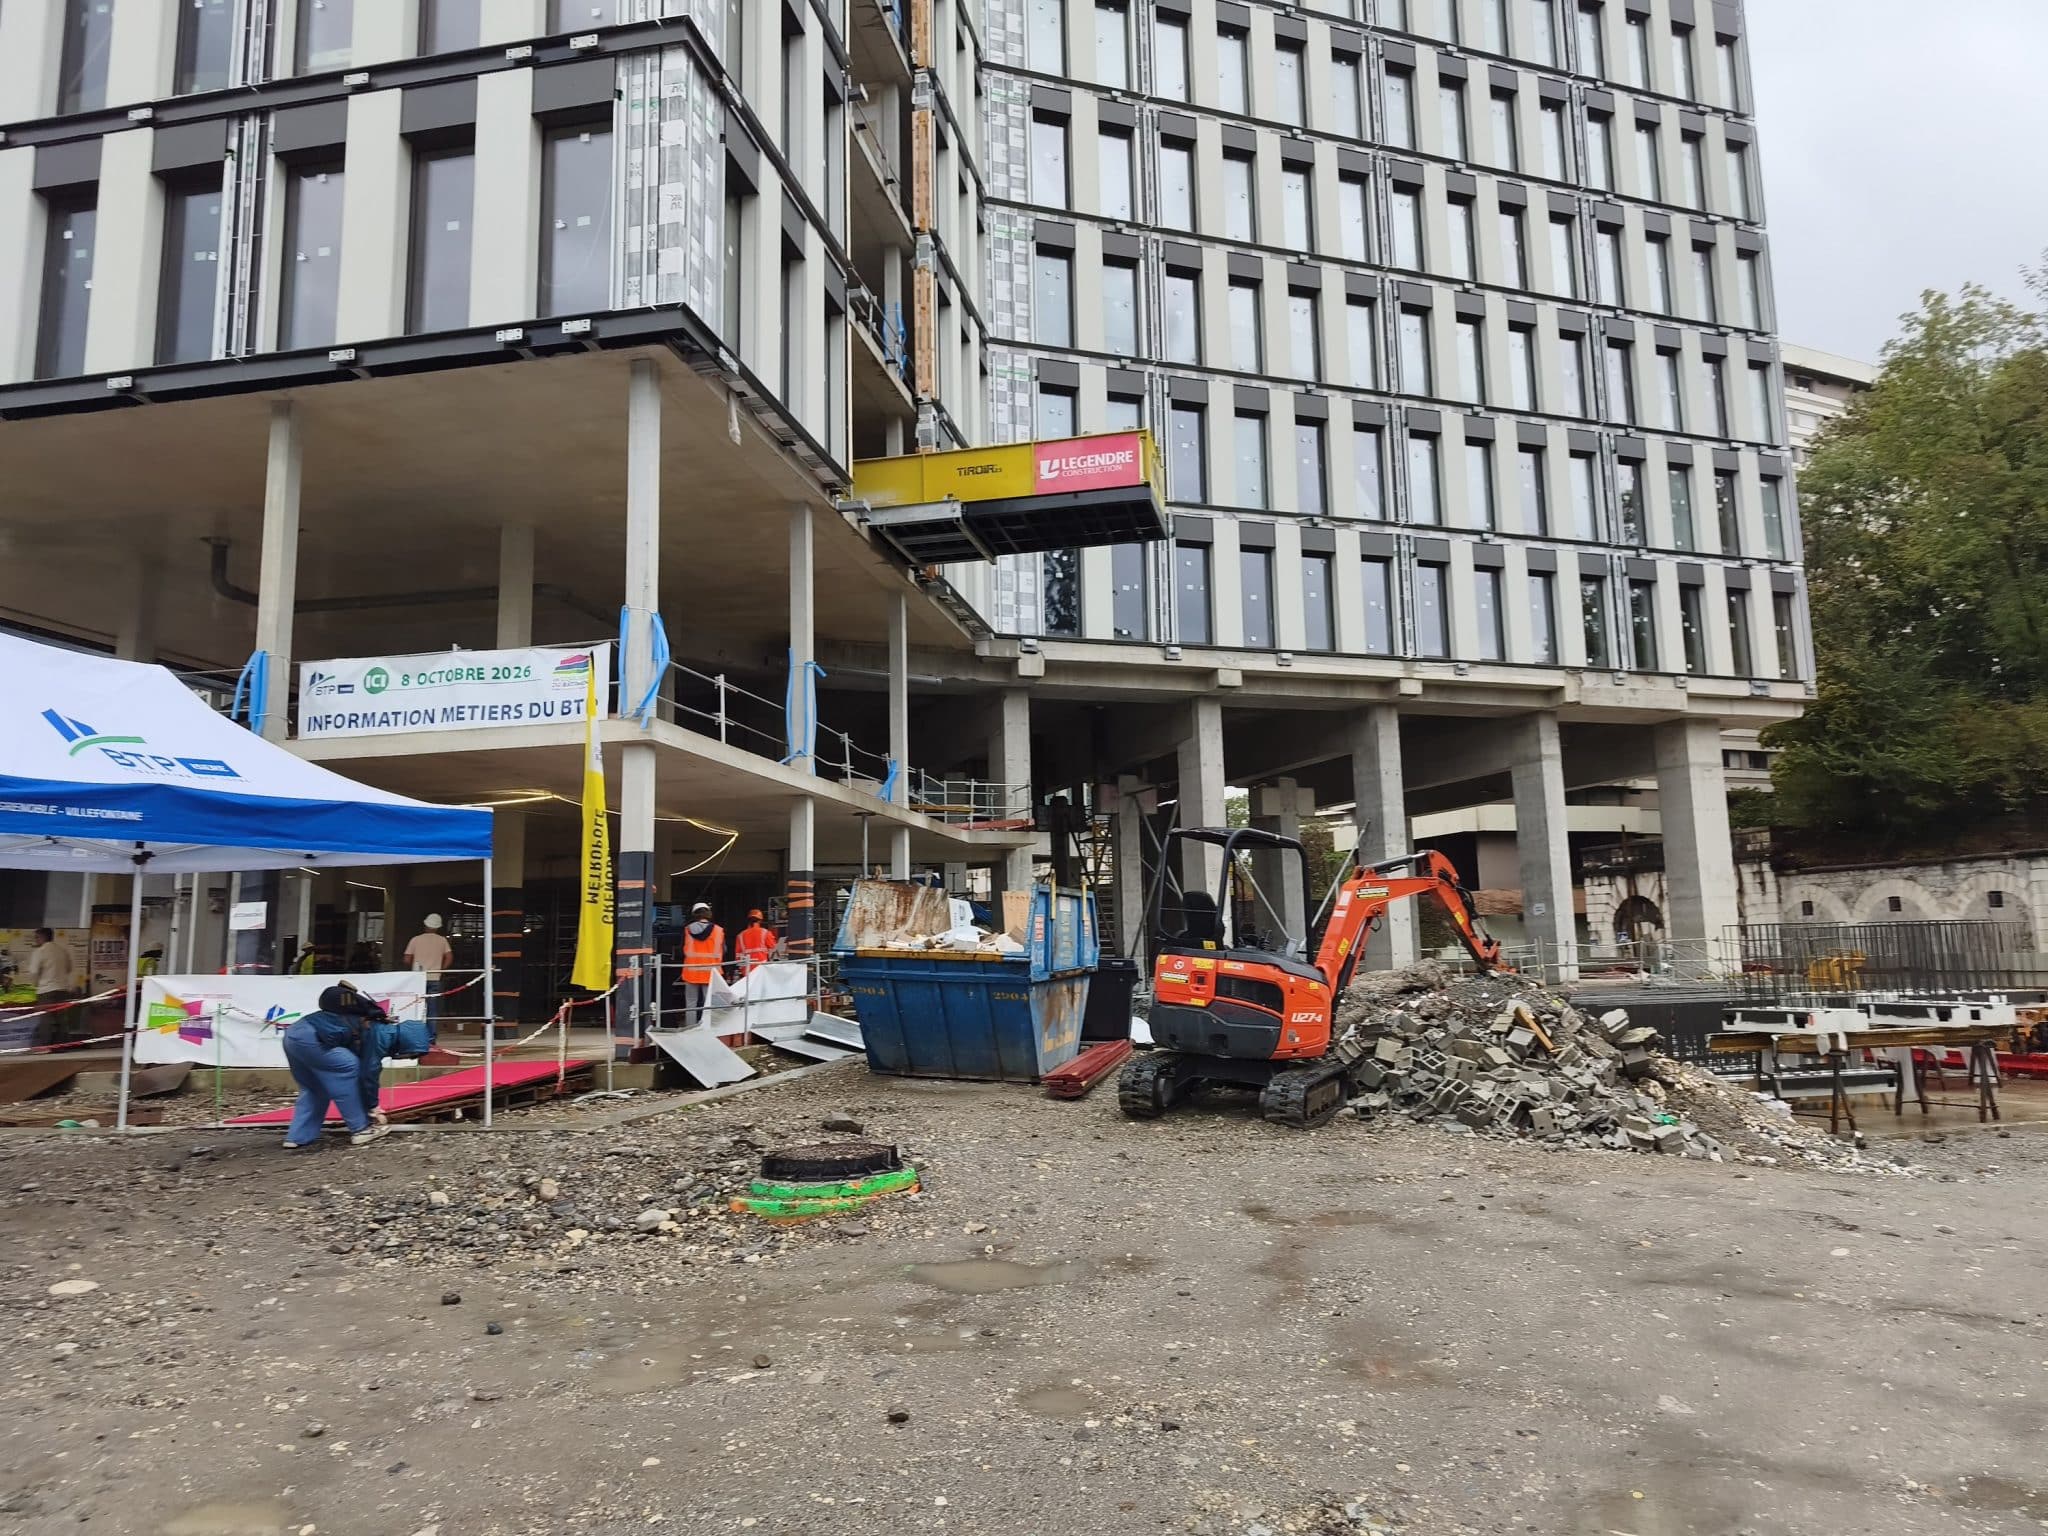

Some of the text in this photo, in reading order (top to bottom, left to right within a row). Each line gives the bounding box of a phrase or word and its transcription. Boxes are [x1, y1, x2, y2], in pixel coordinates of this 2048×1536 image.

[1061, 450, 1134, 470] LEGENDRE
[1061, 464, 1123, 477] CONSTRUCTION
[365, 674, 387, 689] ICI
[401, 665, 531, 686] 8 OCTOBRE 2026
[307, 698, 599, 732] INFORMATION METIERS DU BT
[99, 747, 176, 772] BTP
